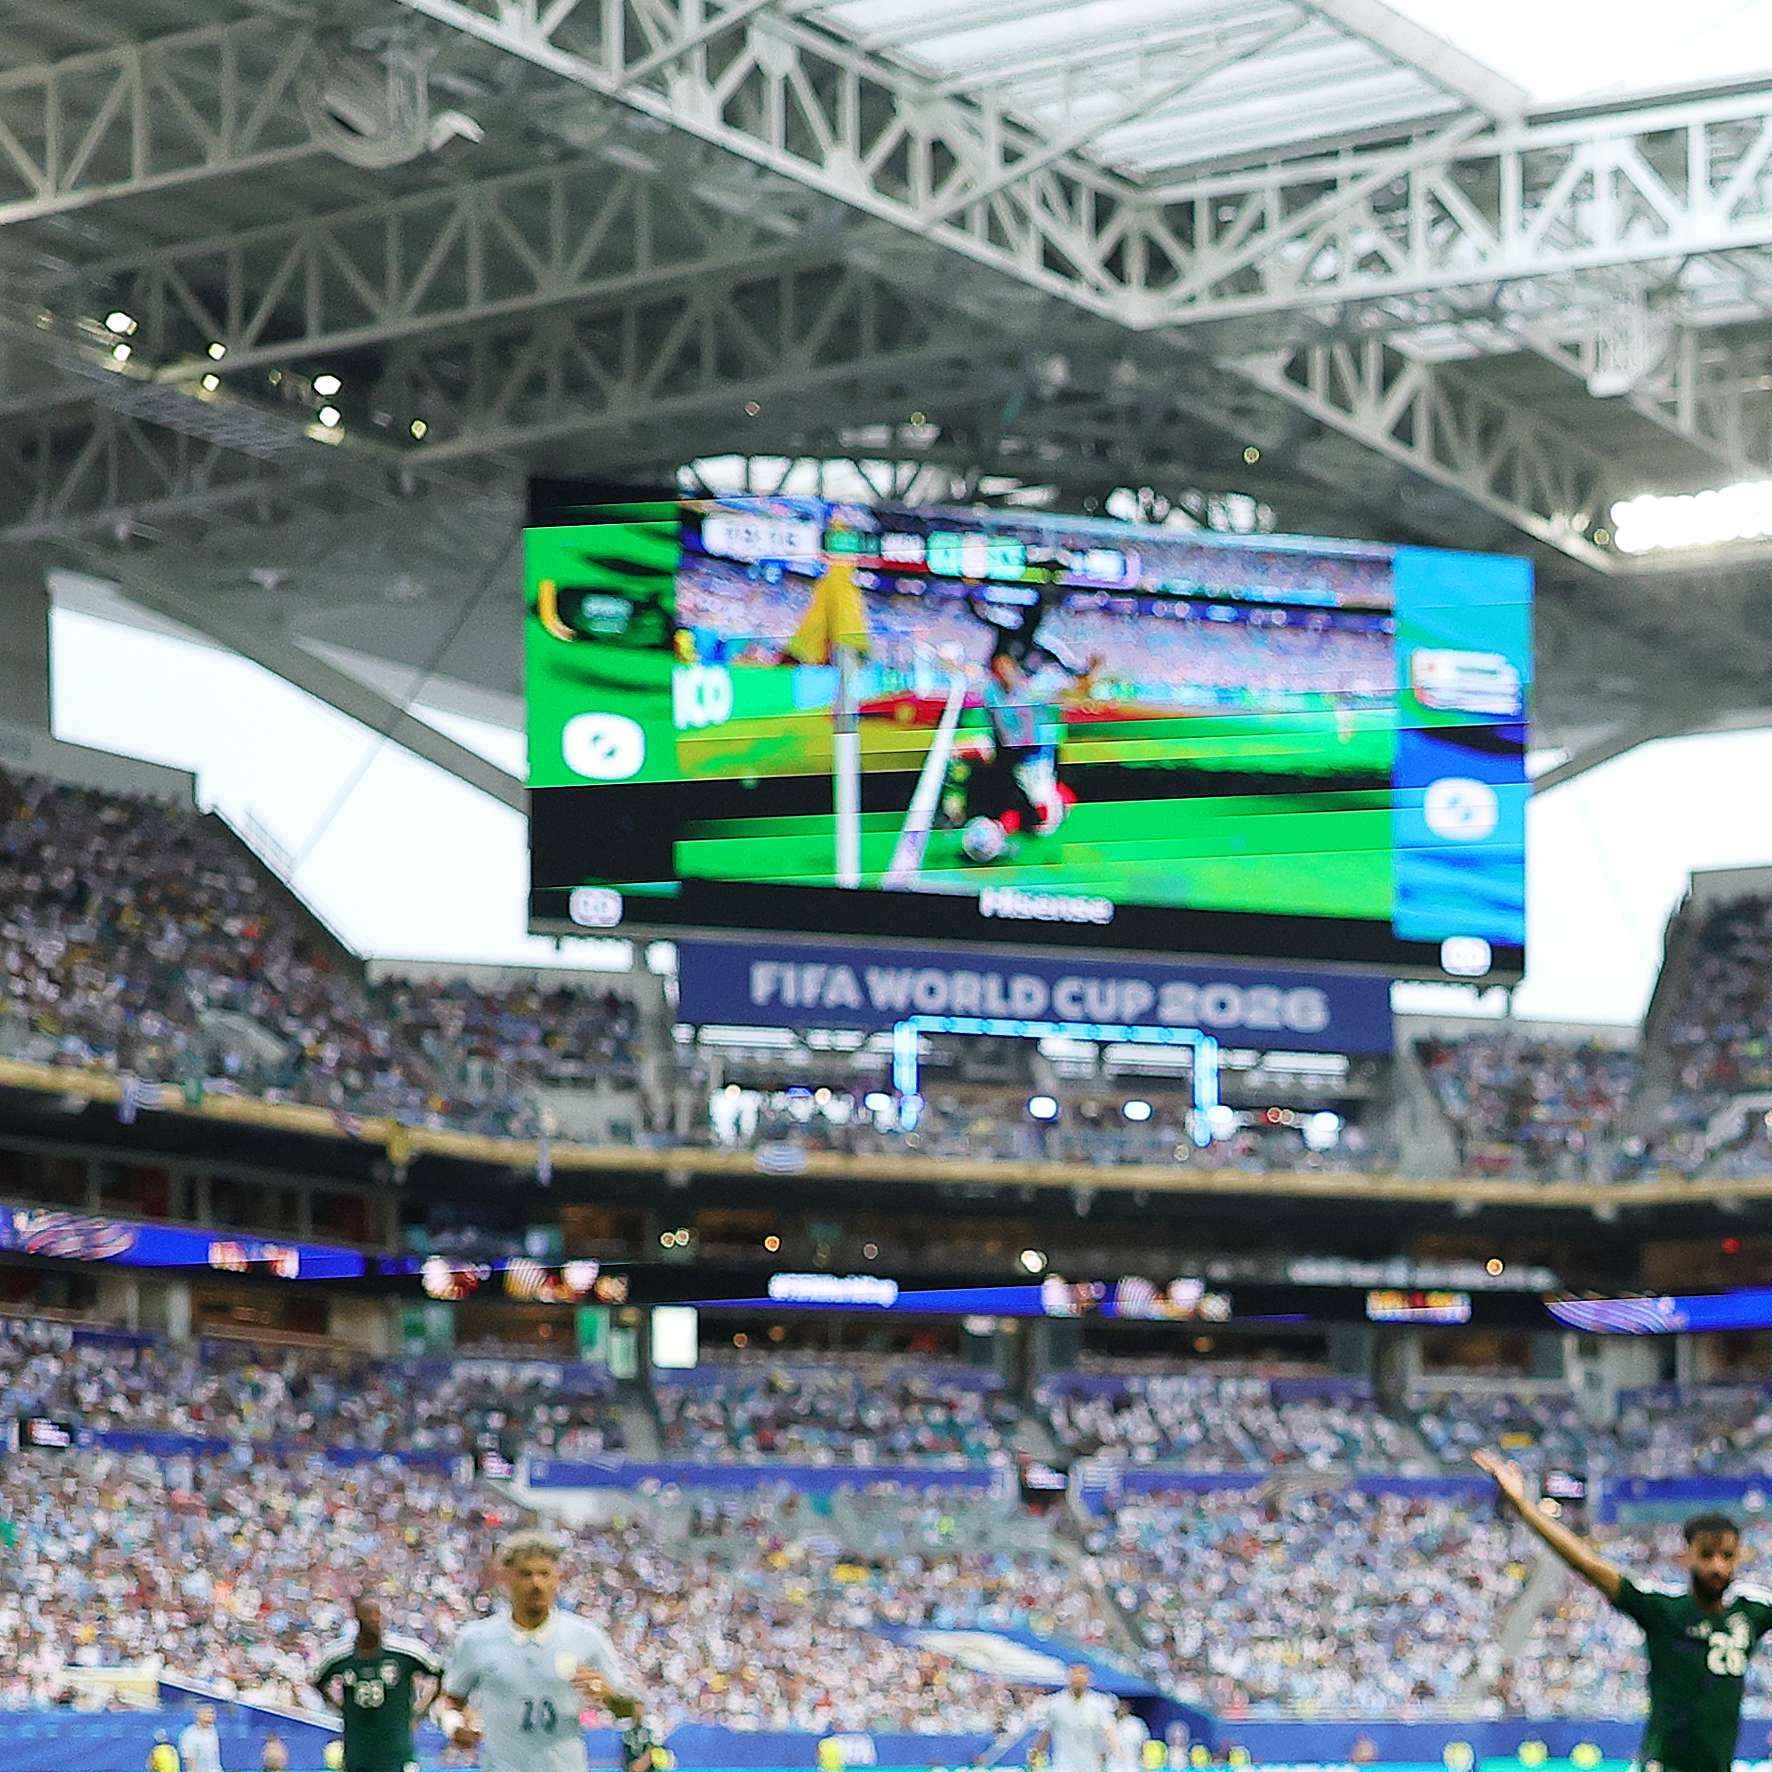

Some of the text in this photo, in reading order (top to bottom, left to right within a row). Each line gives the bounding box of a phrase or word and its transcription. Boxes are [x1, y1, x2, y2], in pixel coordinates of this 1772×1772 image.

[750, 962, 1330, 1032] FIFA WORLD CUP 2026
